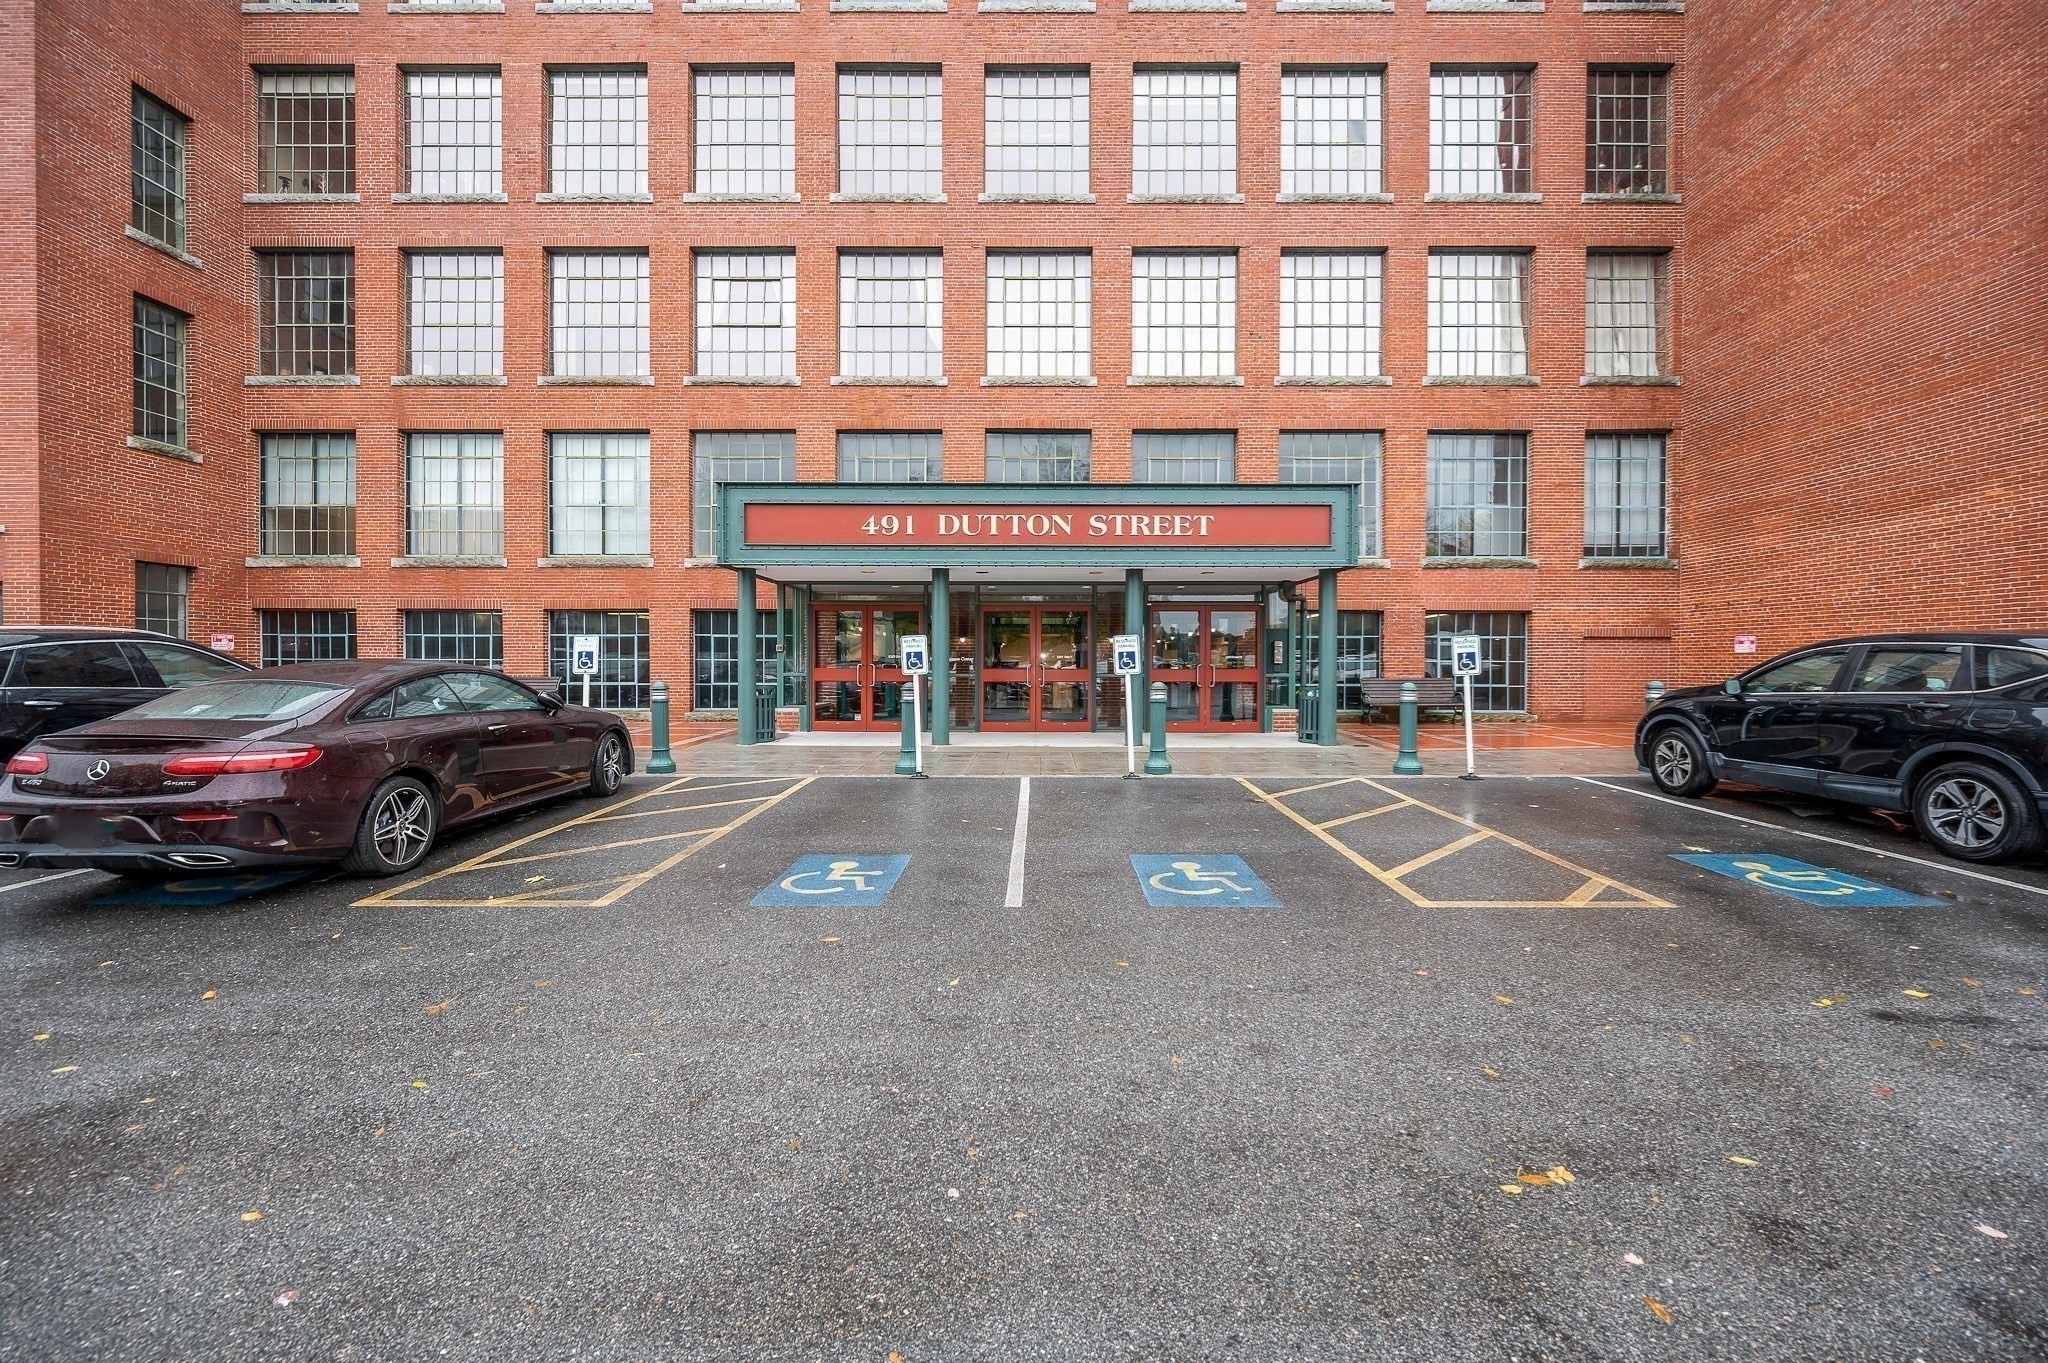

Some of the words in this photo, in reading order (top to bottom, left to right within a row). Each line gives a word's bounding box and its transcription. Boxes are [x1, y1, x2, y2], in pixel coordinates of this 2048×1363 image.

[860, 514, 915, 536] 491
[937, 514, 1073, 536] DUTTON
[1087, 514, 1215, 536] STREET
